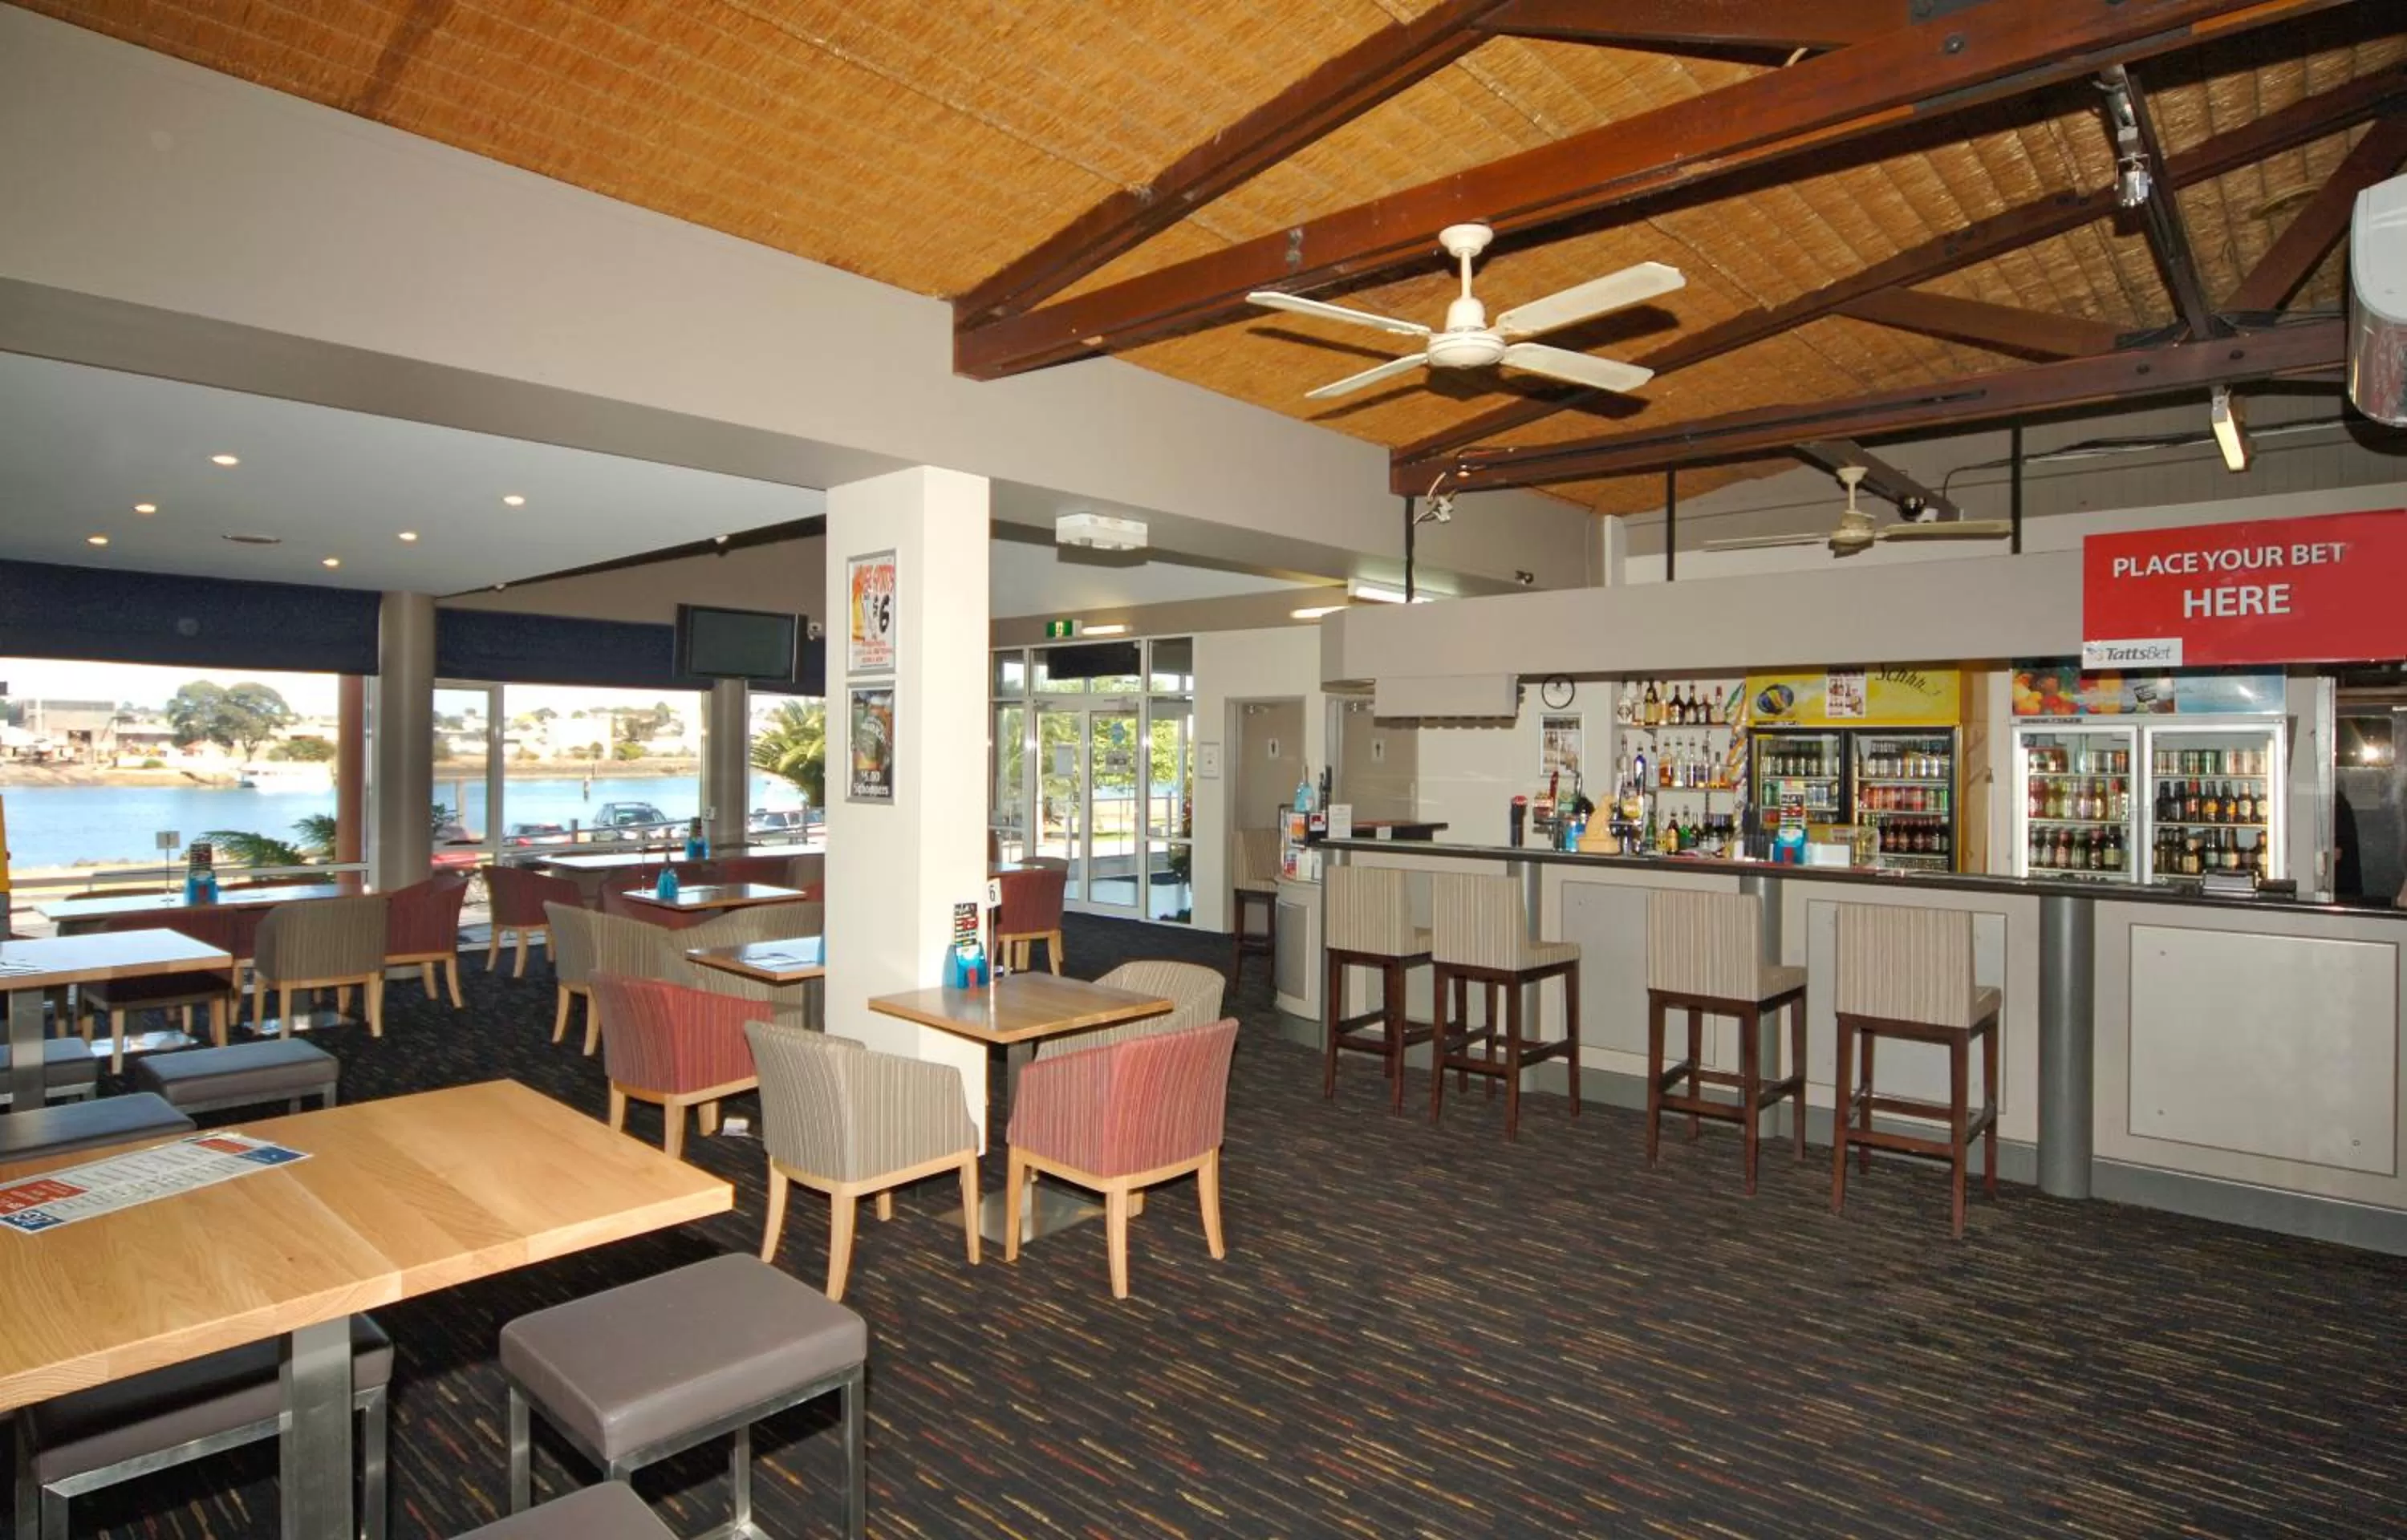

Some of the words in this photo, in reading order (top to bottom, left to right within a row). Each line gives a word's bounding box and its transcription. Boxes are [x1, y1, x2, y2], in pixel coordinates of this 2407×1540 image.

[2113, 552, 2198, 578] PLACE
[2202, 546, 2283, 571] YOUR
[2291, 542, 2346, 565] BET
[2183, 584, 2291, 618] HERE
[2105, 646, 2171, 662] TattsBet
